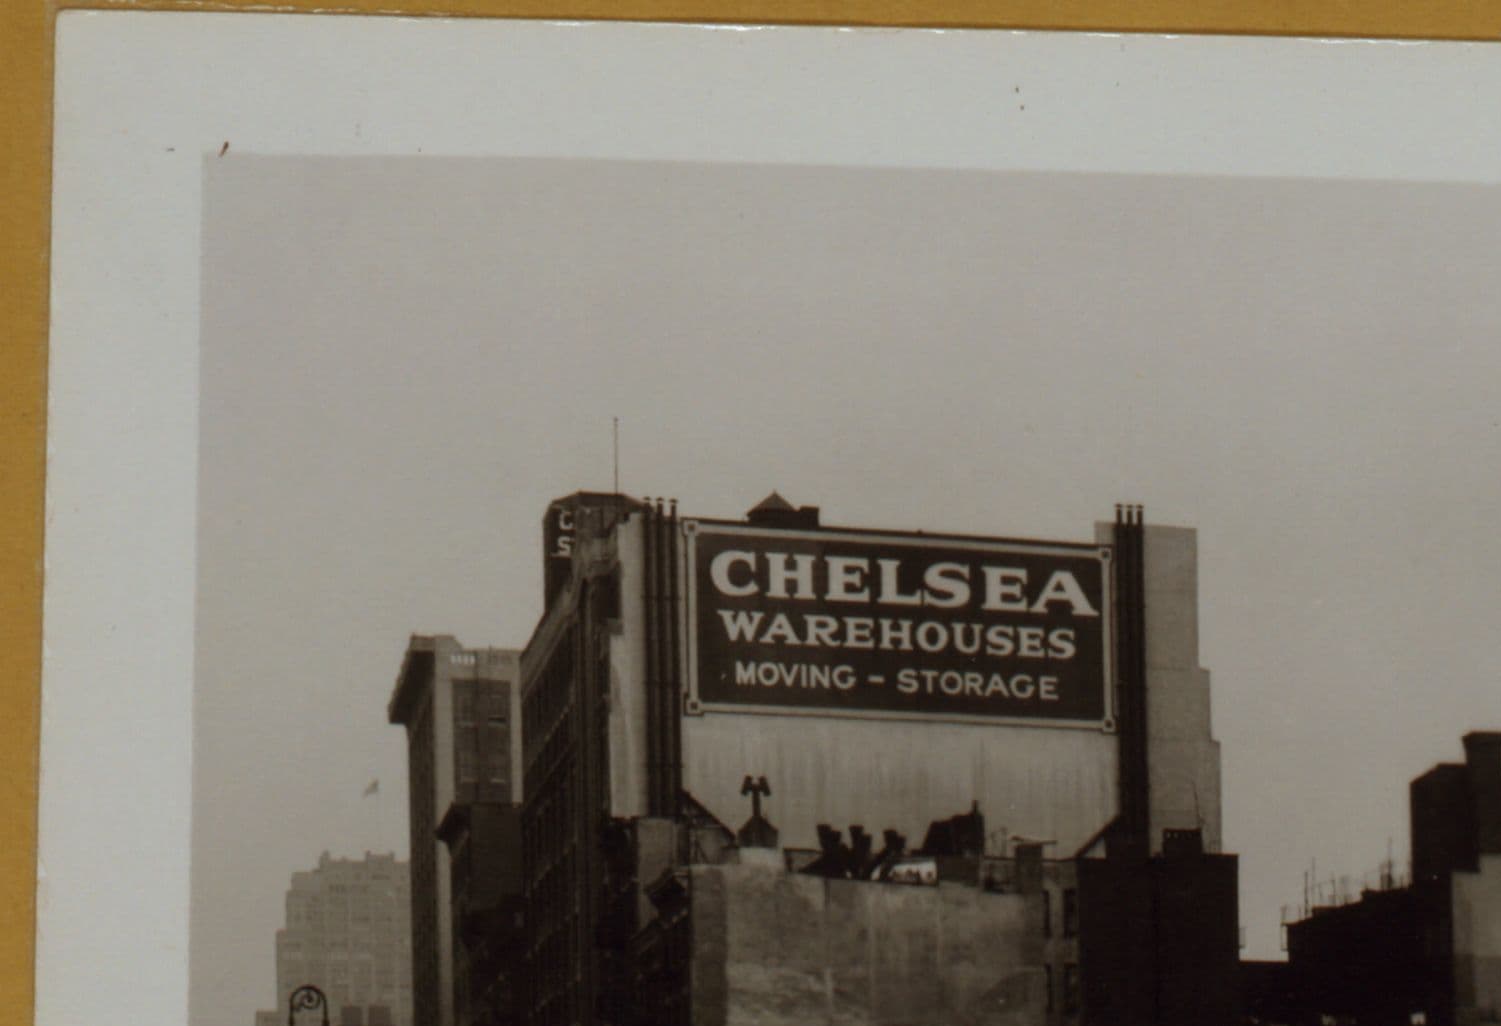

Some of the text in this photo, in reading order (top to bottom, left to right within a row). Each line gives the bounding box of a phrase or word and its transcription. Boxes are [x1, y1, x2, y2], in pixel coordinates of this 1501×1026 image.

[710, 550, 1100, 617] CHELSEA
[717, 609, 1076, 660] WAREHOUSES
[735, 661, 857, 690] MOVING
[896, 667, 1060, 701] STORAGE
